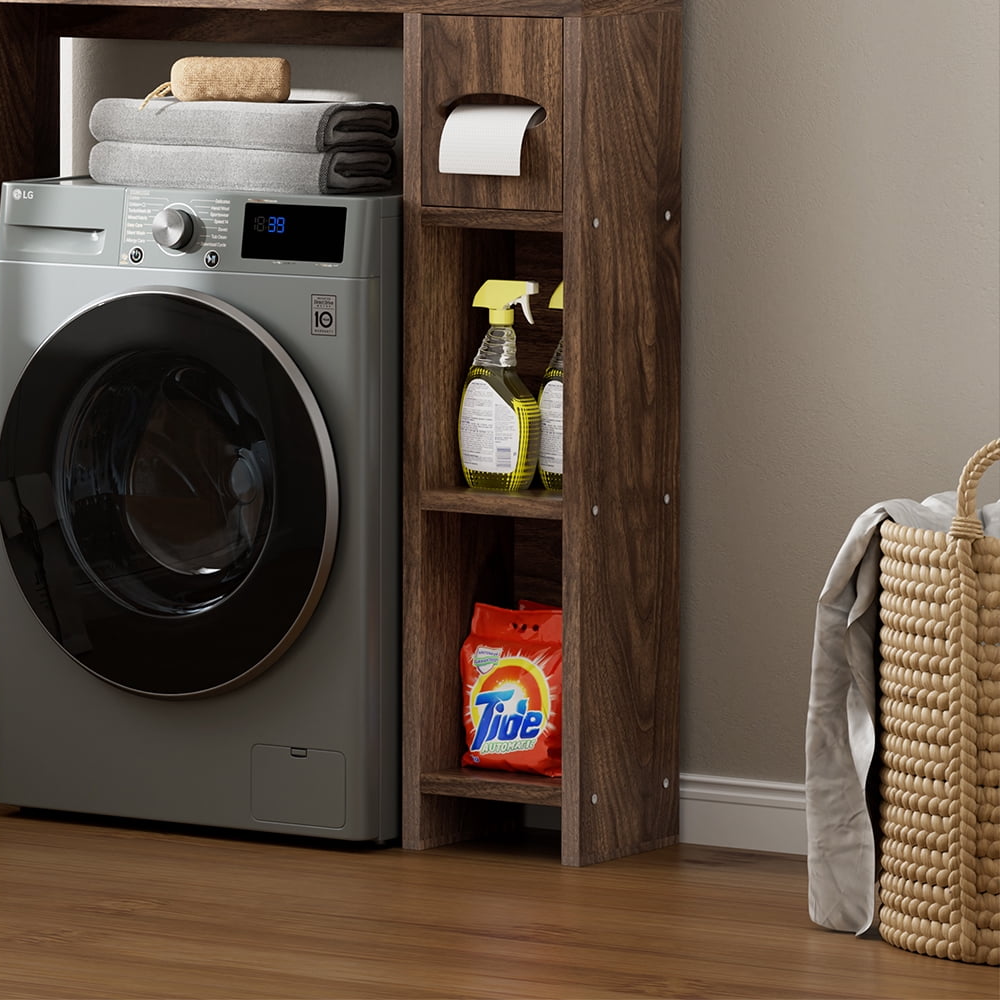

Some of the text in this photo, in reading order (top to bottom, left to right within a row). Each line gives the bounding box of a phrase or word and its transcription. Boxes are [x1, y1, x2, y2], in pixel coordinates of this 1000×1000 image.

[22, 191, 34, 200] LG
[314, 311, 333, 329] 10
[471, 689, 544, 751] Tide
[481, 739, 536, 754] AUTOMATIC
